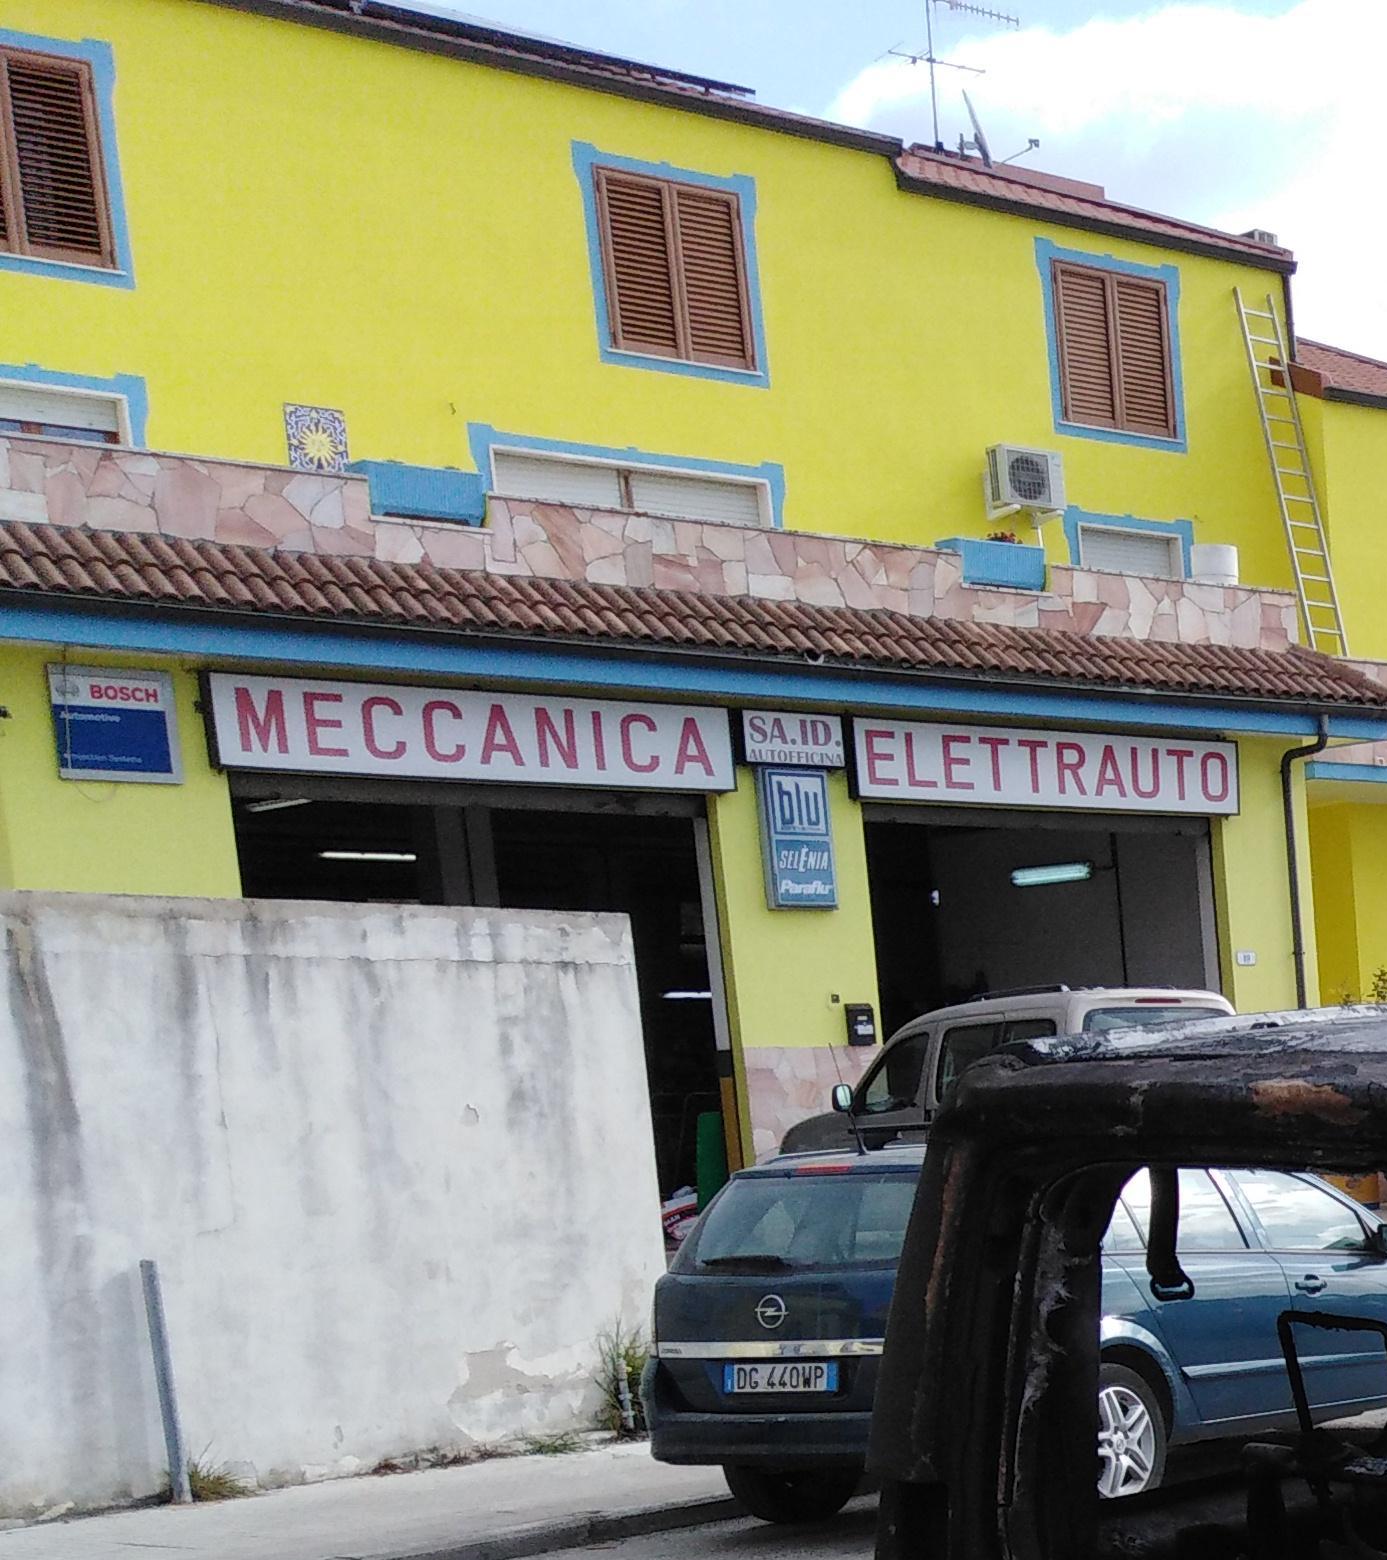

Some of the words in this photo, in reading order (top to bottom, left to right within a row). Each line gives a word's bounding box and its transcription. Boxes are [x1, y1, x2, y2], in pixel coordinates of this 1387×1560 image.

[89, 684, 159, 703] BOSCH
[234, 686, 716, 777] MECCANICA
[748, 715, 842, 747] SA.ID.
[749, 748, 844, 765] AUTOFFICINA
[864, 729, 1229, 803] ELETTRAUTO
[776, 780, 820, 826] blu
[736, 1367, 759, 1390] DG
[766, 1365, 825, 1389] 440WP
